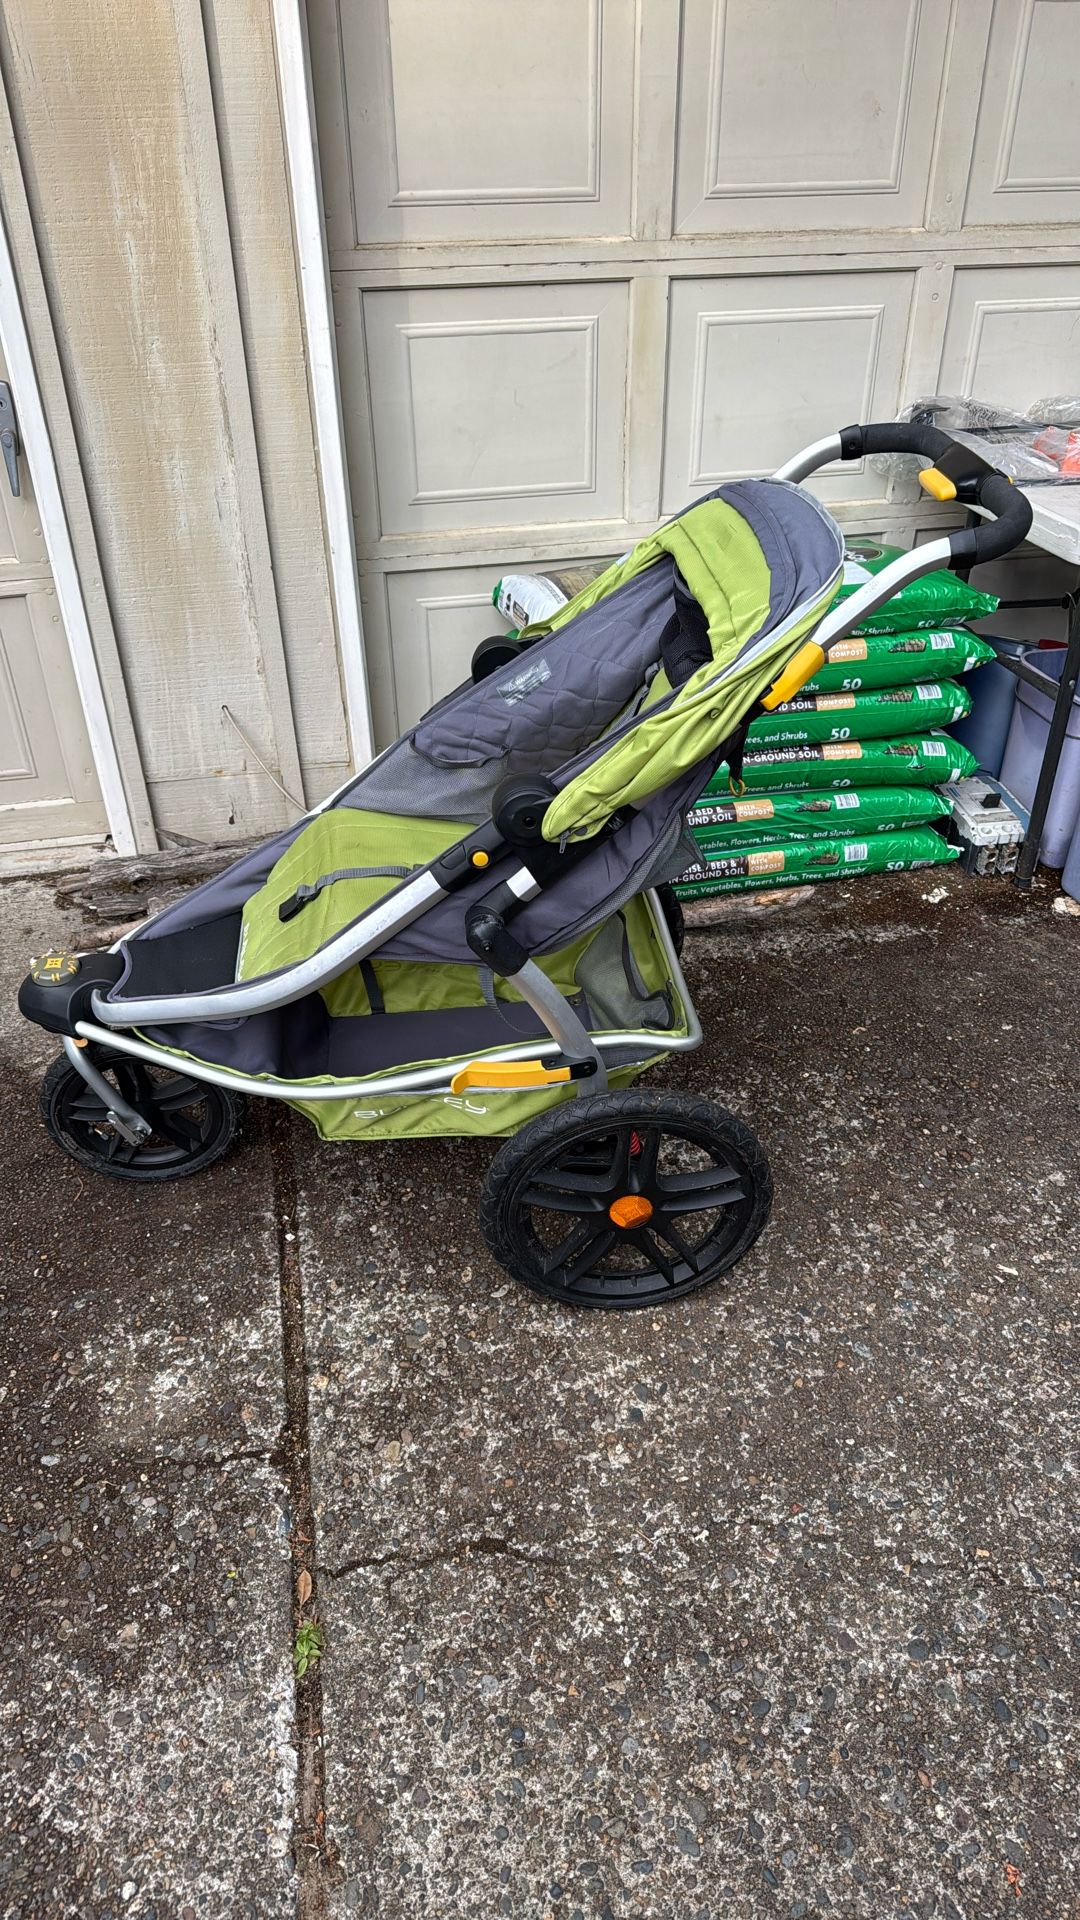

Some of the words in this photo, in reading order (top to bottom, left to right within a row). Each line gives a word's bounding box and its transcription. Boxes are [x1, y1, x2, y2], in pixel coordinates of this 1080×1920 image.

[830, 649, 864, 658] COMPOST
[799, 682, 820, 692] rubs
[841, 678, 862, 691] 50
[791, 701, 814, 710] SOIL
[818, 698, 852, 706] COMPOST
[744, 736, 763, 745] rees,
[764, 732, 780, 742] and
[780, 730, 808, 741] Shrubs
[830, 727, 851, 740] 50
[743, 752, 796, 764] N-GROUND
[799, 750, 821, 759] SOIL
[830, 778, 851, 788] 50
[696, 807, 714, 817] BED
[712, 813, 734, 823] SOIL
[739, 808, 771, 818] COMPOST
[699, 840, 729, 850] etables,
[813, 830, 828, 839] and
[829, 828, 856, 838] Shrubs
[711, 861, 728, 870] BED
[730, 859, 737, 868] &
[725, 867, 746, 876] SOIL
[751, 862, 782, 872] COMPOST
[676, 887, 699, 897] Fruits,
[701, 881, 743, 893] Vegetables,
[745, 877, 774, 887] Flowers,
[776, 872, 800, 883] Herbs,
[801, 871, 824, 880] Trees,
[825, 869, 840, 878] and
[841, 866, 868, 876] Shrubs
[886, 861, 905, 871] 50
